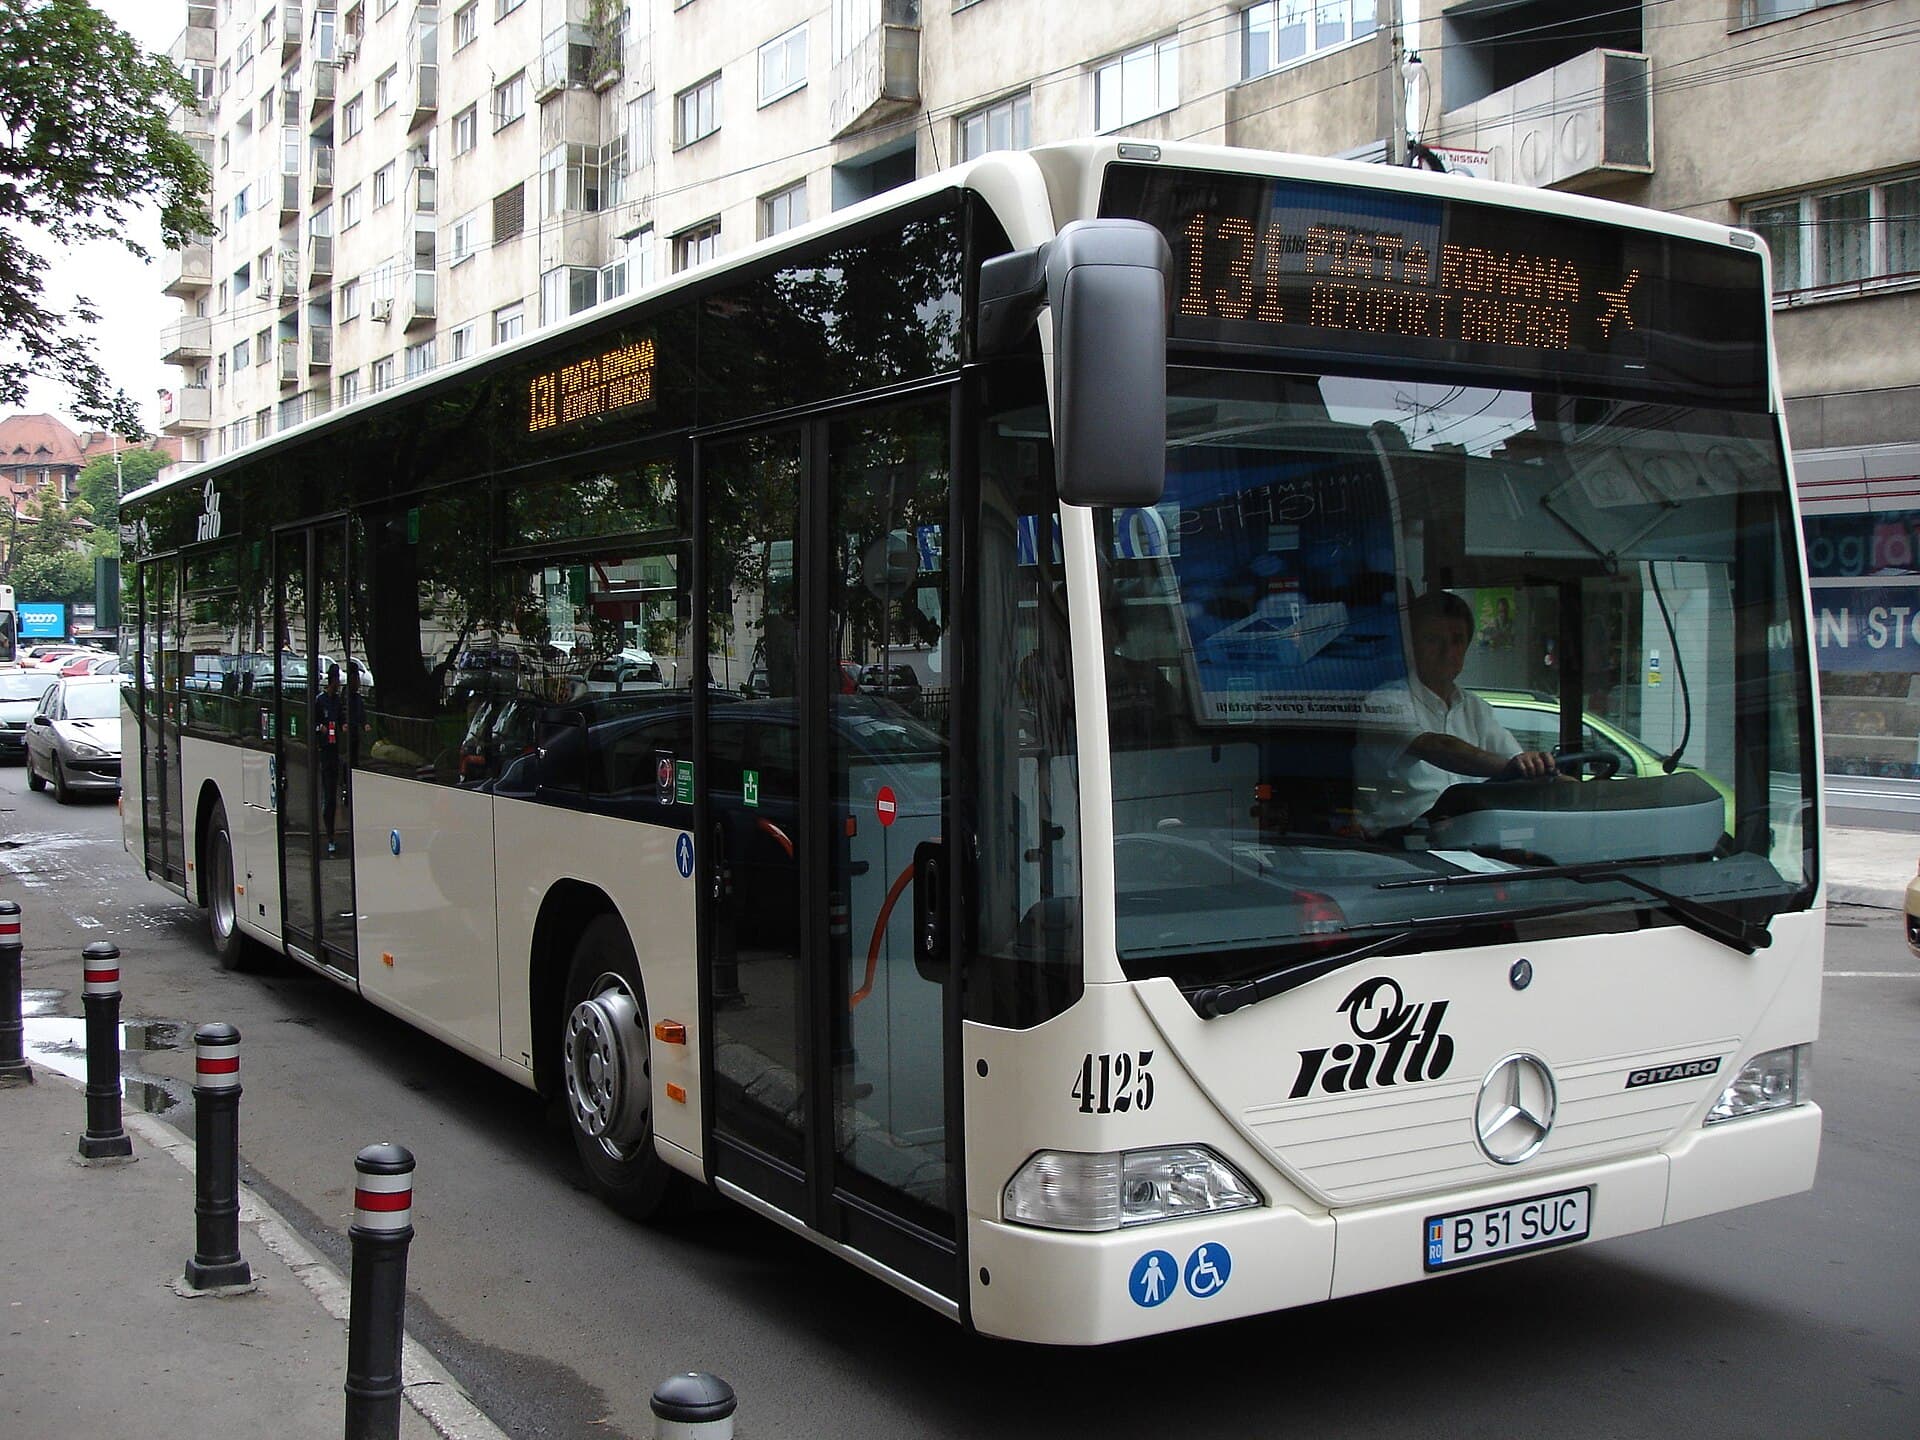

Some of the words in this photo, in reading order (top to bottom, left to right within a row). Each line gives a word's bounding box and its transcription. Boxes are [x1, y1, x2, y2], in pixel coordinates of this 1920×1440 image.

[1449, 154, 1488, 165] NISSAN
[1179, 213, 1285, 323] 131
[1306, 228, 1428, 286] PIATA
[1442, 244, 1580, 303] ROMANA
[1311, 281, 1452, 338] AEROPORT
[529, 372, 557, 432] 131
[561, 357, 599, 395] PIATA
[1809, 533, 1920, 576] ogra
[1071, 1050, 1156, 1114] 4125
[1630, 1060, 1718, 1085] CITARO
[1429, 1244, 1442, 1260] RO
[1455, 1221, 1474, 1255] B
[1485, 1215, 1511, 1247] 51
[1520, 1200, 1577, 1238] SUC
